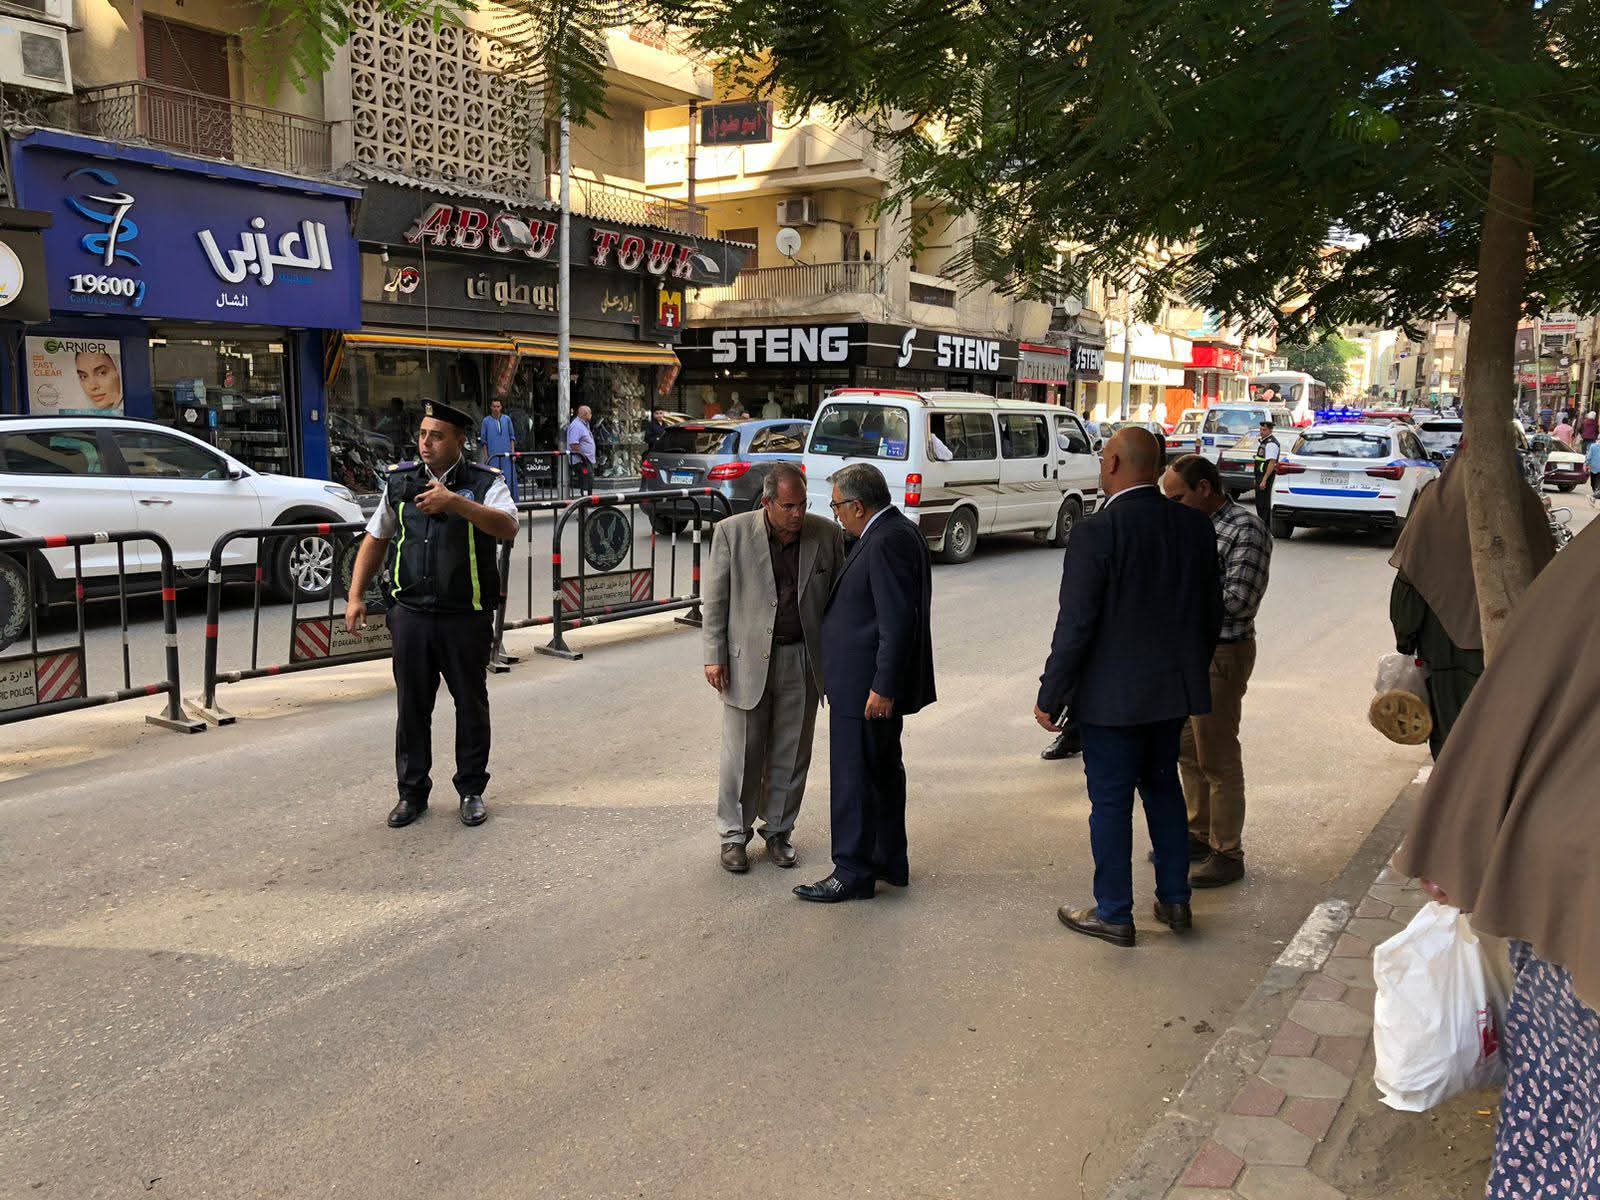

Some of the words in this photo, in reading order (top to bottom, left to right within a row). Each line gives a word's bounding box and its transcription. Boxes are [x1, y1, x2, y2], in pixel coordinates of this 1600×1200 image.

[68, 273, 135, 297] 19600
[215, 292, 249, 308] الشال
[44, 339, 106, 354] GARNIER
[712, 327, 849, 363] STENG
[937, 335, 1000, 371] STENG
[10, 686, 34, 699] POLICE
